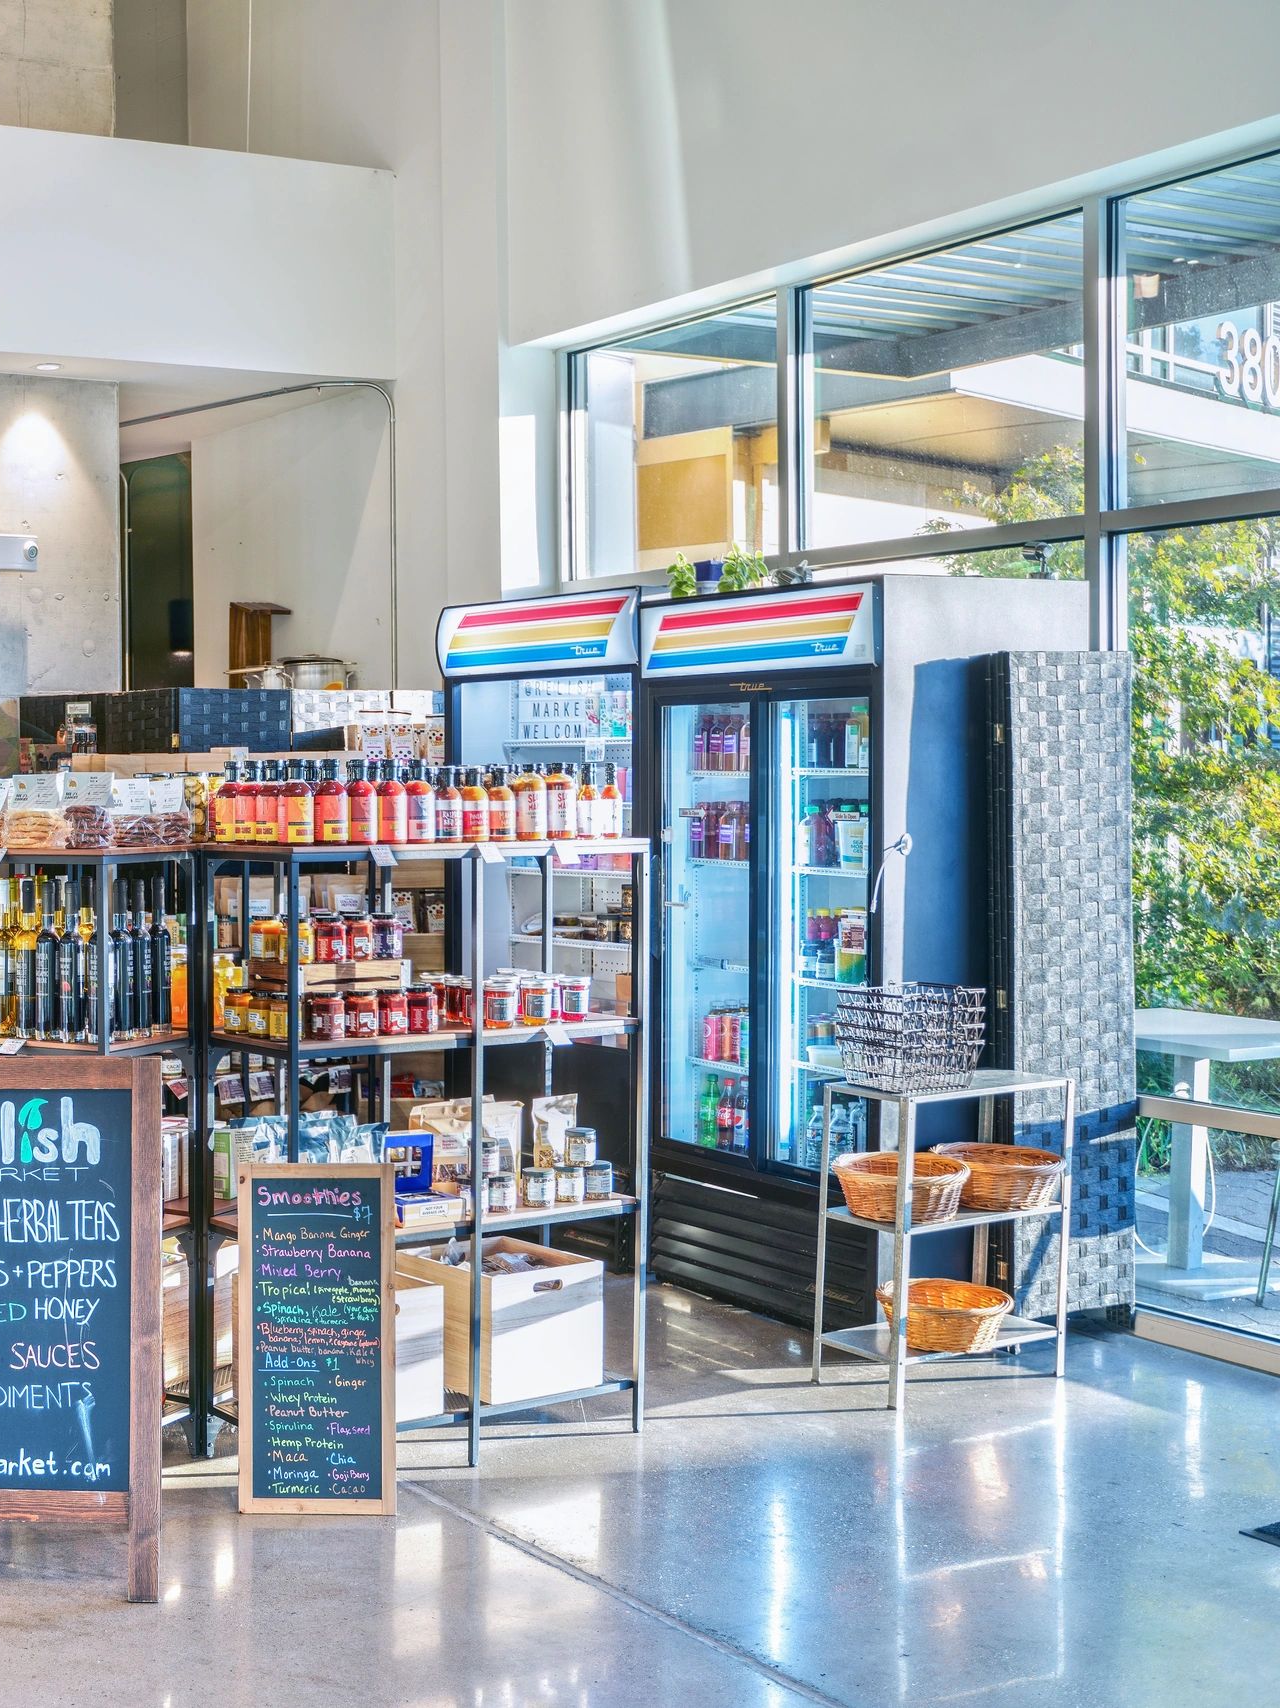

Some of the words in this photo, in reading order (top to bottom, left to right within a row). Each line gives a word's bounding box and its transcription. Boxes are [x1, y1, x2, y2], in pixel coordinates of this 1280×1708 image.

[570, 645, 600, 655] true
[811, 641, 839, 652] true
[532, 701, 580, 718] MARKE
[523, 724, 583, 739] WELCOM
[257, 1185, 362, 1207] Smoothies
[66, 1199, 120, 1242] TEAS
[353, 1205, 373, 1224] $7
[263, 1227, 297, 1244] Mango
[300, 1227, 336, 1240] Banana
[340, 1227, 370, 1241] Ginger
[262, 1244, 323, 1262] Strawberry
[328, 1243, 371, 1259] Banana
[27, 1259, 117, 1288] PEPPERS
[261, 1265, 297, 1277] Mixed
[305, 1265, 341, 1281] Berry
[259, 1281, 310, 1300] Tropical
[34, 1297, 100, 1325] HONEY
[312, 1305, 341, 1317] Kale
[10, 1341, 100, 1370] SAUCES
[265, 1352, 317, 1369] Add-Ons
[326, 1357, 340, 1371] $1
[271, 1376, 315, 1391] Spinach
[335, 1375, 366, 1390] Ginger
[270, 1392, 300, 1407] Whey
[303, 1392, 337, 1404] Protein
[270, 1404, 305, 1417] Peanut
[309, 1407, 349, 1418] Butter
[270, 1420, 314, 1436] Spirulina
[272, 1437, 302, 1451] Hemp
[305, 1438, 344, 1450] Protein
[273, 1450, 308, 1462] Maca
[330, 1453, 356, 1465] Chia
[273, 1466, 319, 1481] Moringa
[272, 1482, 320, 1495] Turmeric
[333, 1483, 365, 1495] Cacao
